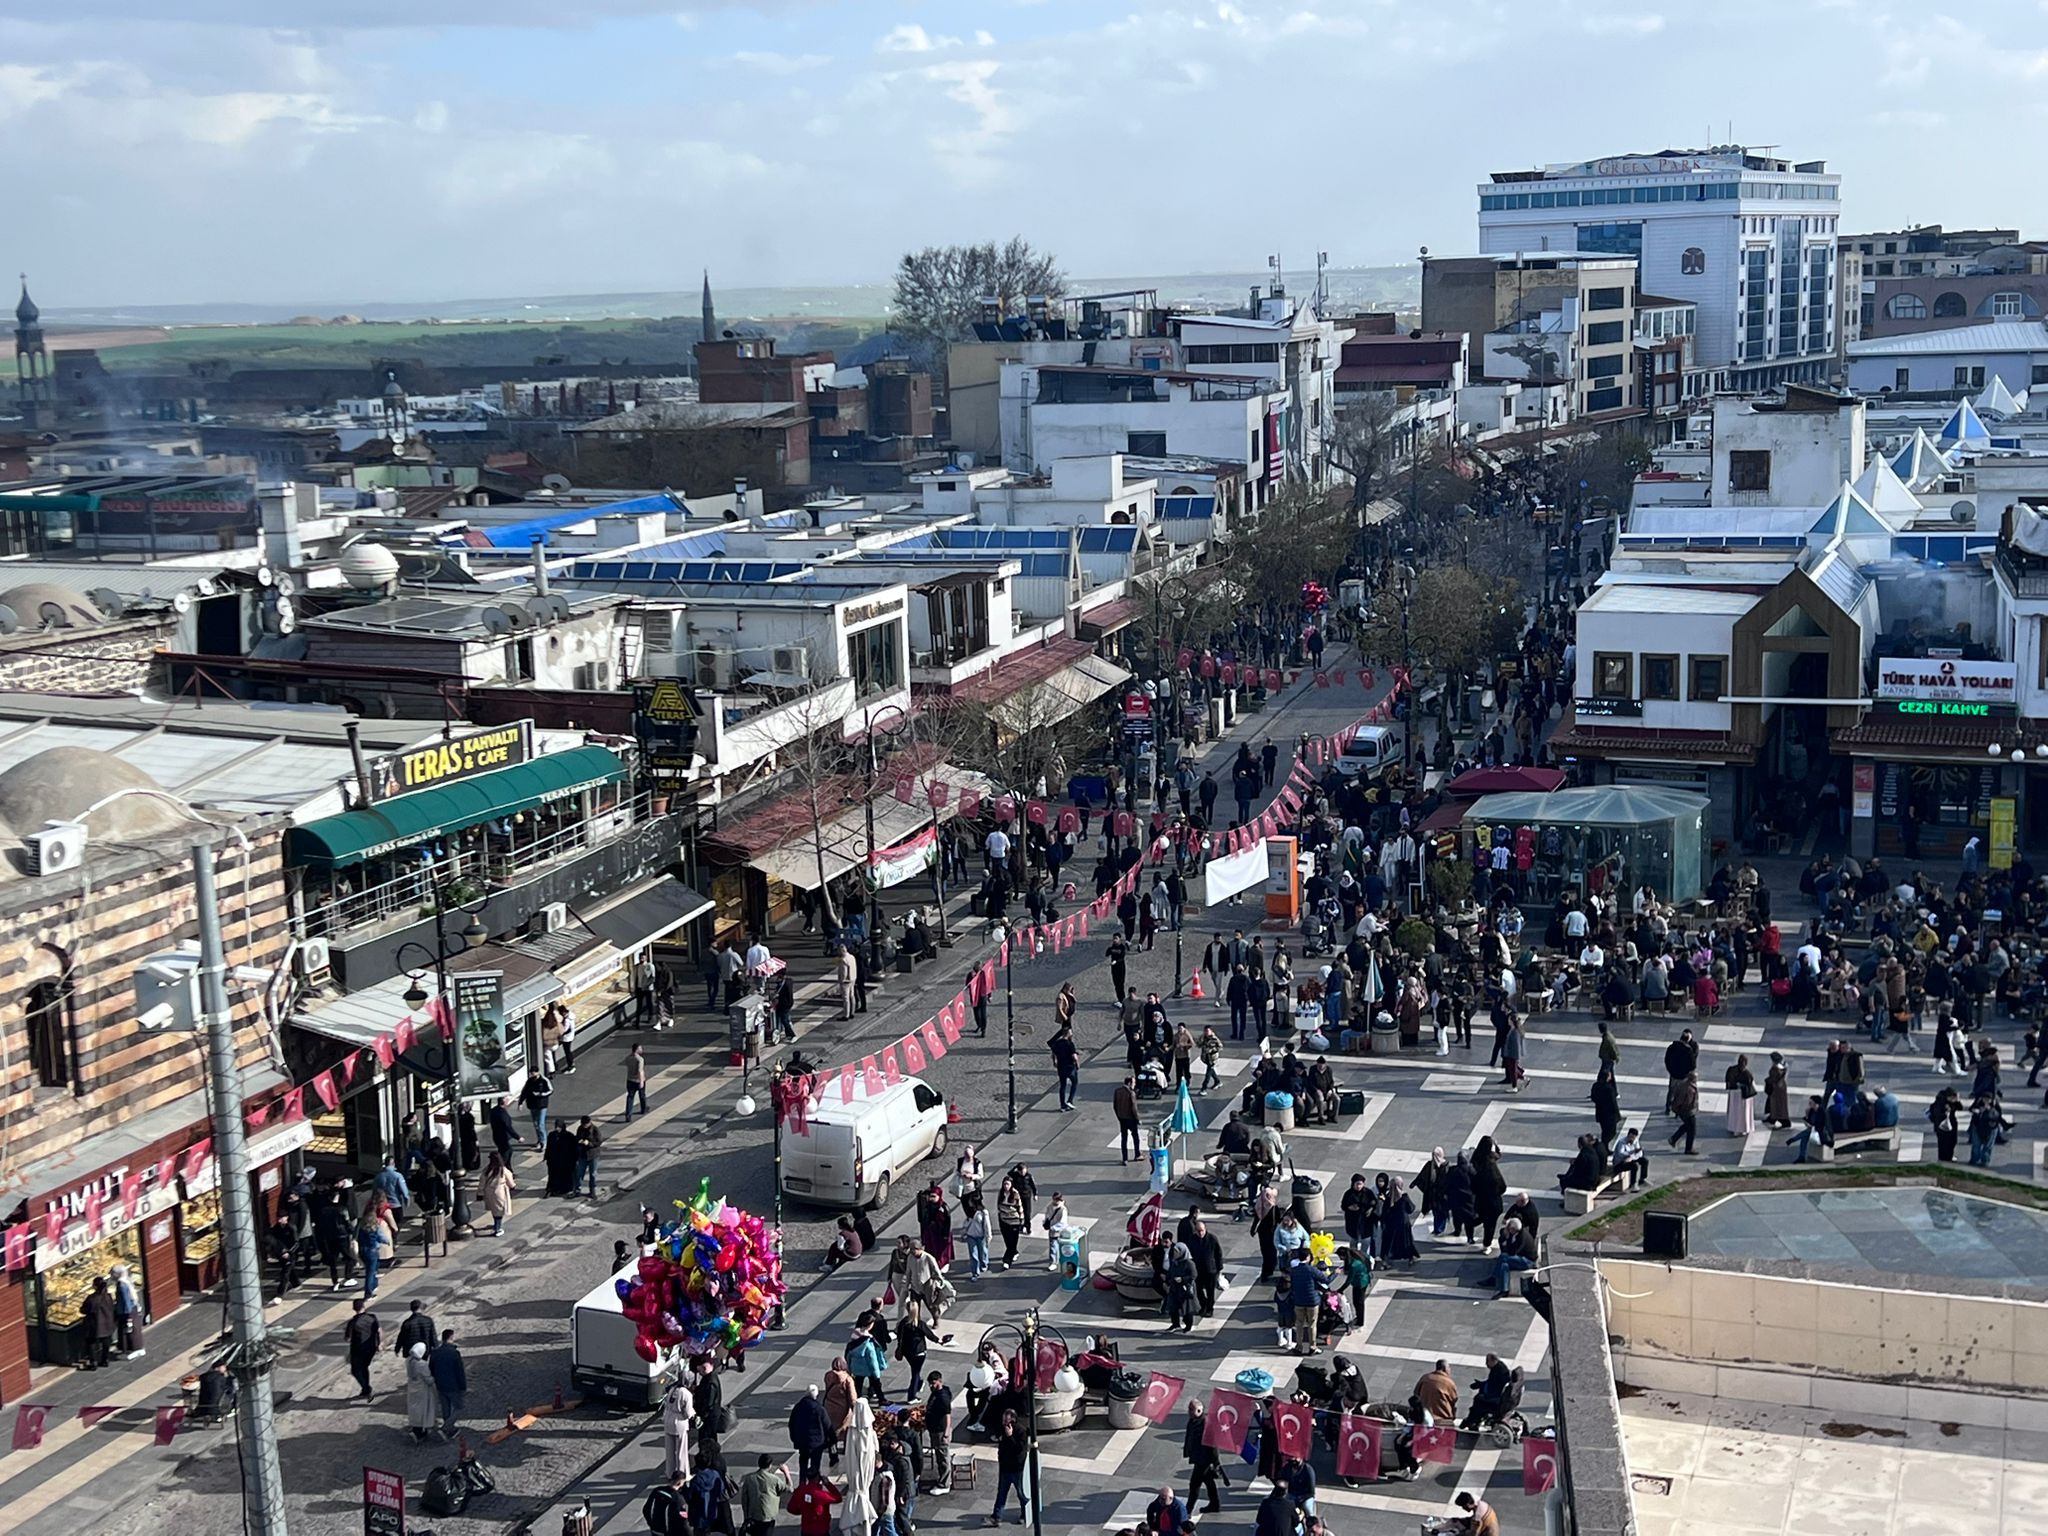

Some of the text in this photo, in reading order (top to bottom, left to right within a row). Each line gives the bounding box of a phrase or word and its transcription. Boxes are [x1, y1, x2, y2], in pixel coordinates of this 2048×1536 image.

[1658, 159, 1701, 173] PARK
[1882, 671, 2014, 690] TÜRK HAVA YOLLARI
[1898, 702, 1989, 716] CEZRİ KAHVE
[463, 728, 519, 754] KAHVALTI
[401, 742, 463, 786] TERAS
[464, 746, 508, 770] & CAFE
[361, 842, 396, 859] TERAS
[376, 1483, 392, 1497] OTO
